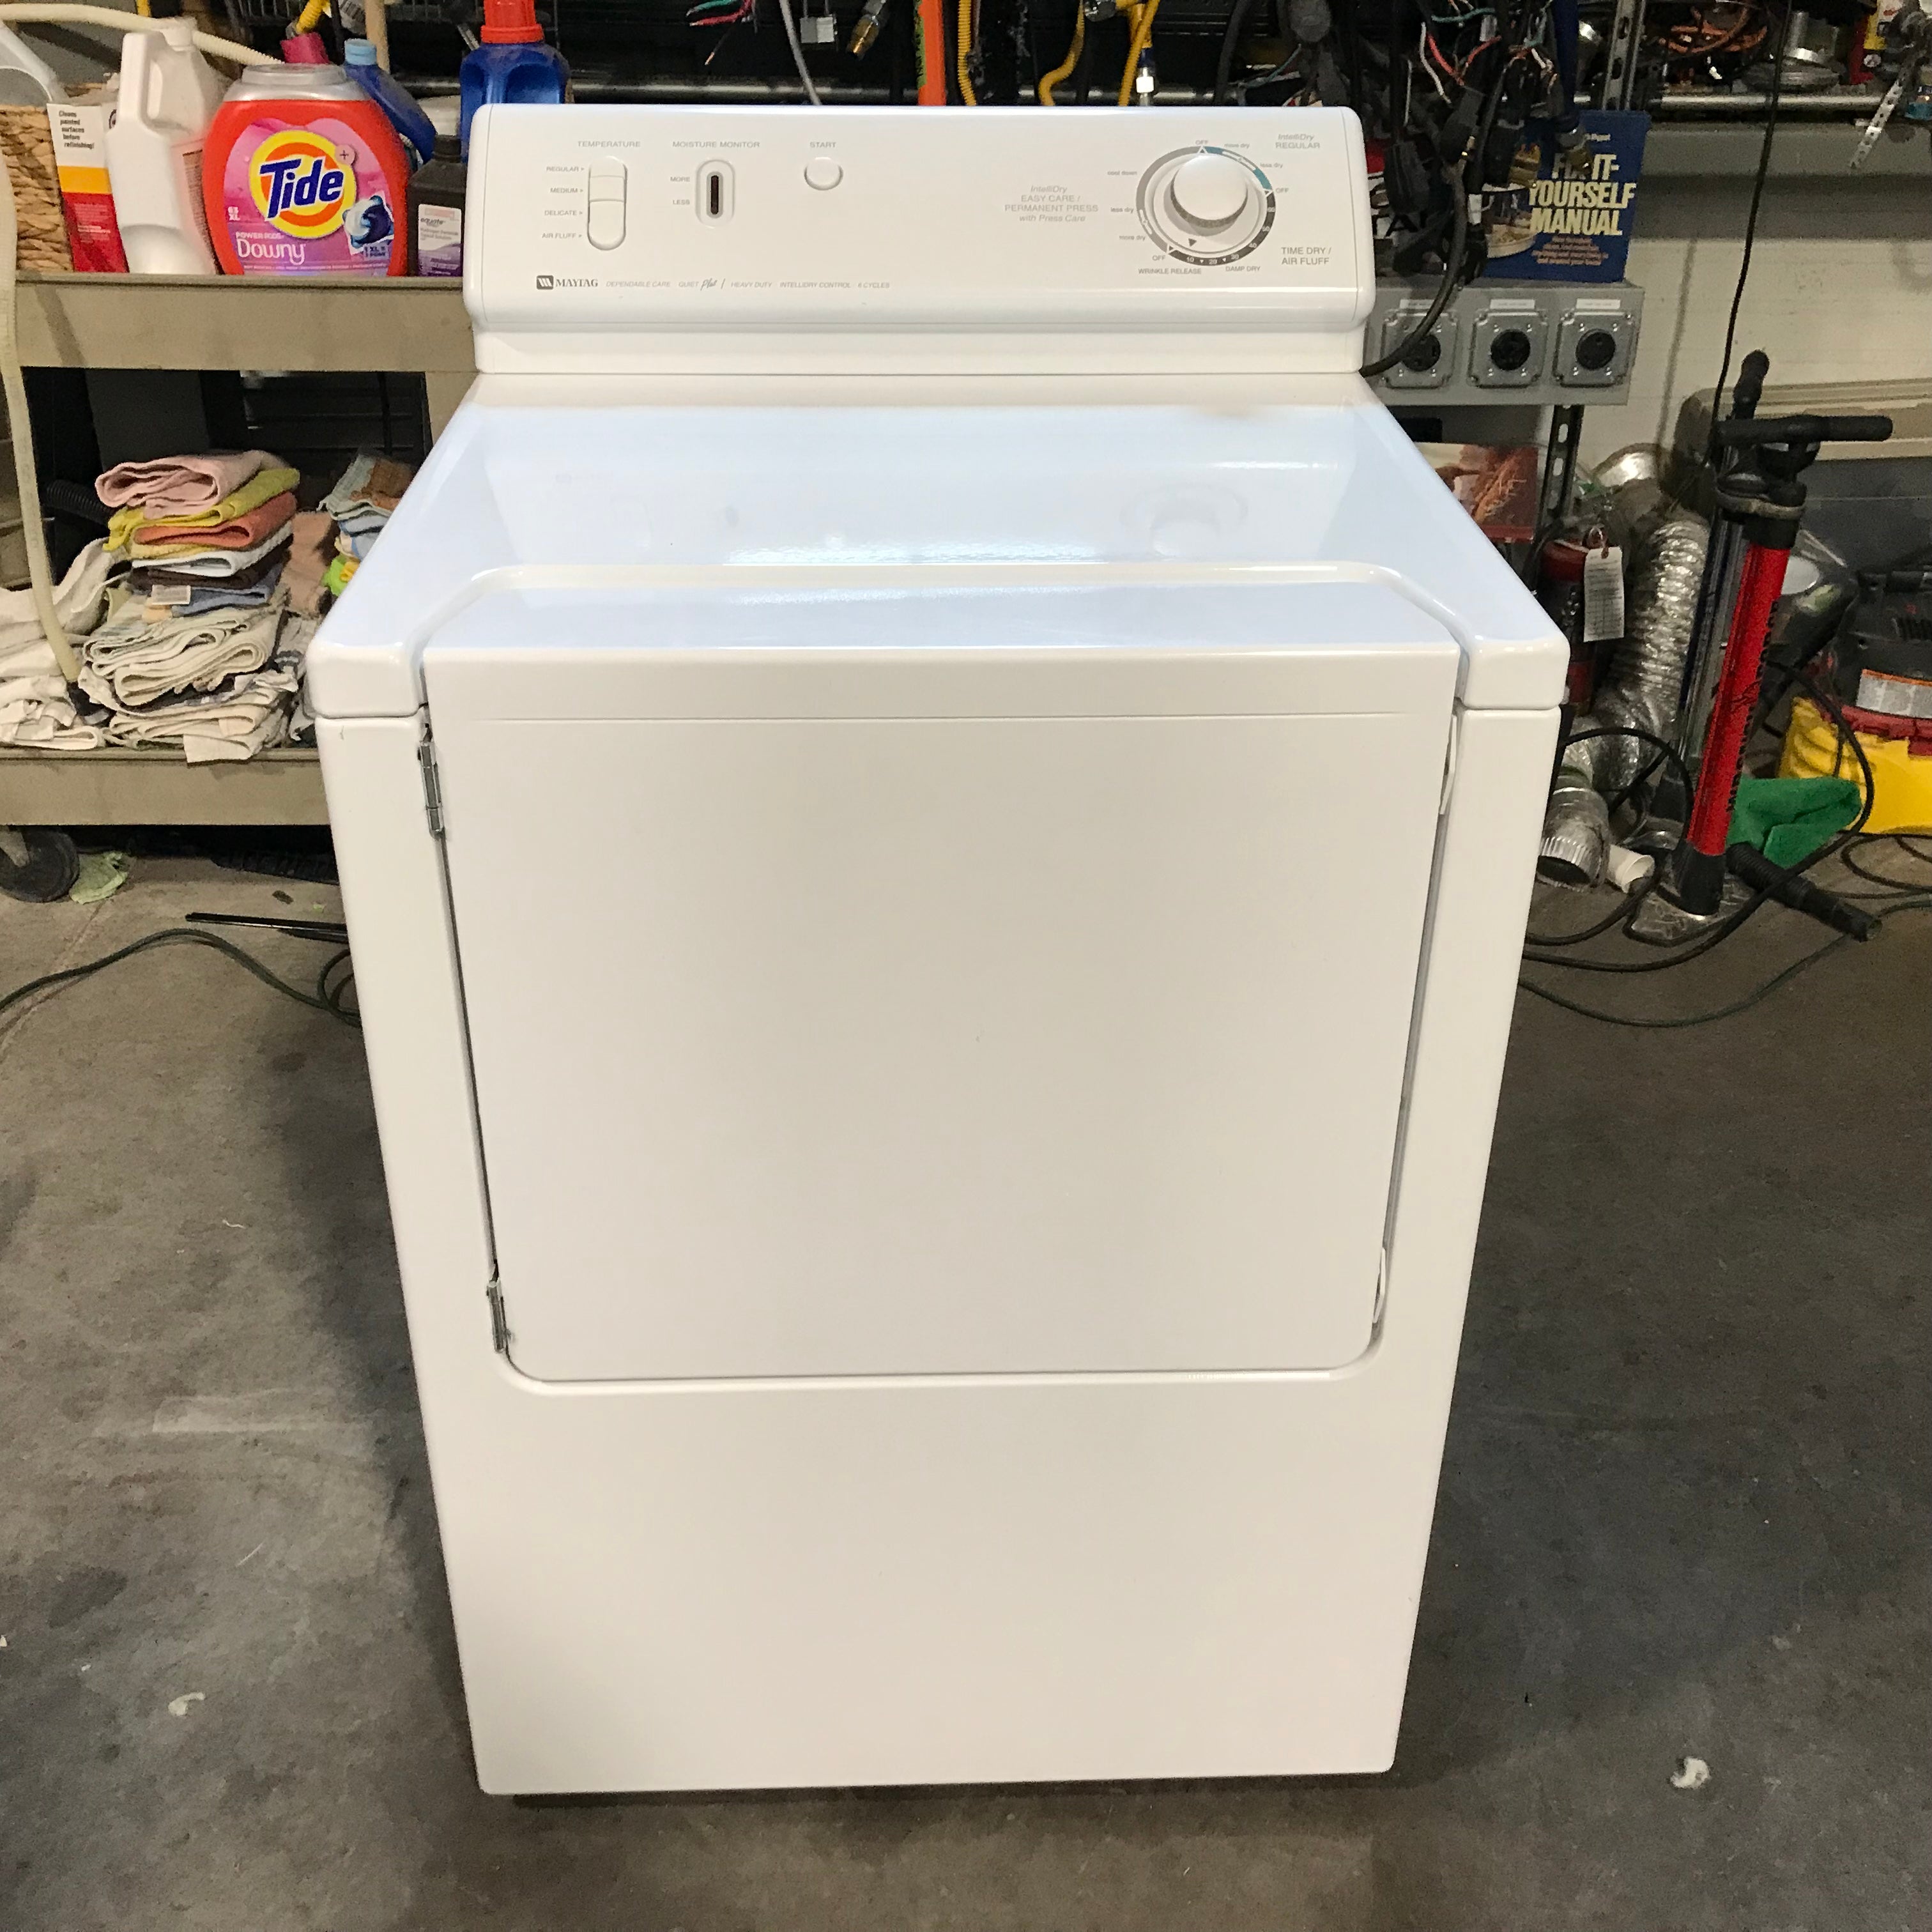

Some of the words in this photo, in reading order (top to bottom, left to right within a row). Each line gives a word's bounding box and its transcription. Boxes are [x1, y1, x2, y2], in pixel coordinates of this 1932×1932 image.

[260, 158, 344, 218] Tide
[1529, 180, 1637, 209] YOURSELF
[1530, 208, 1623, 235] MANUAL
[237, 238, 305, 266] Downy
[556, 279, 599, 288] MAYTAG
